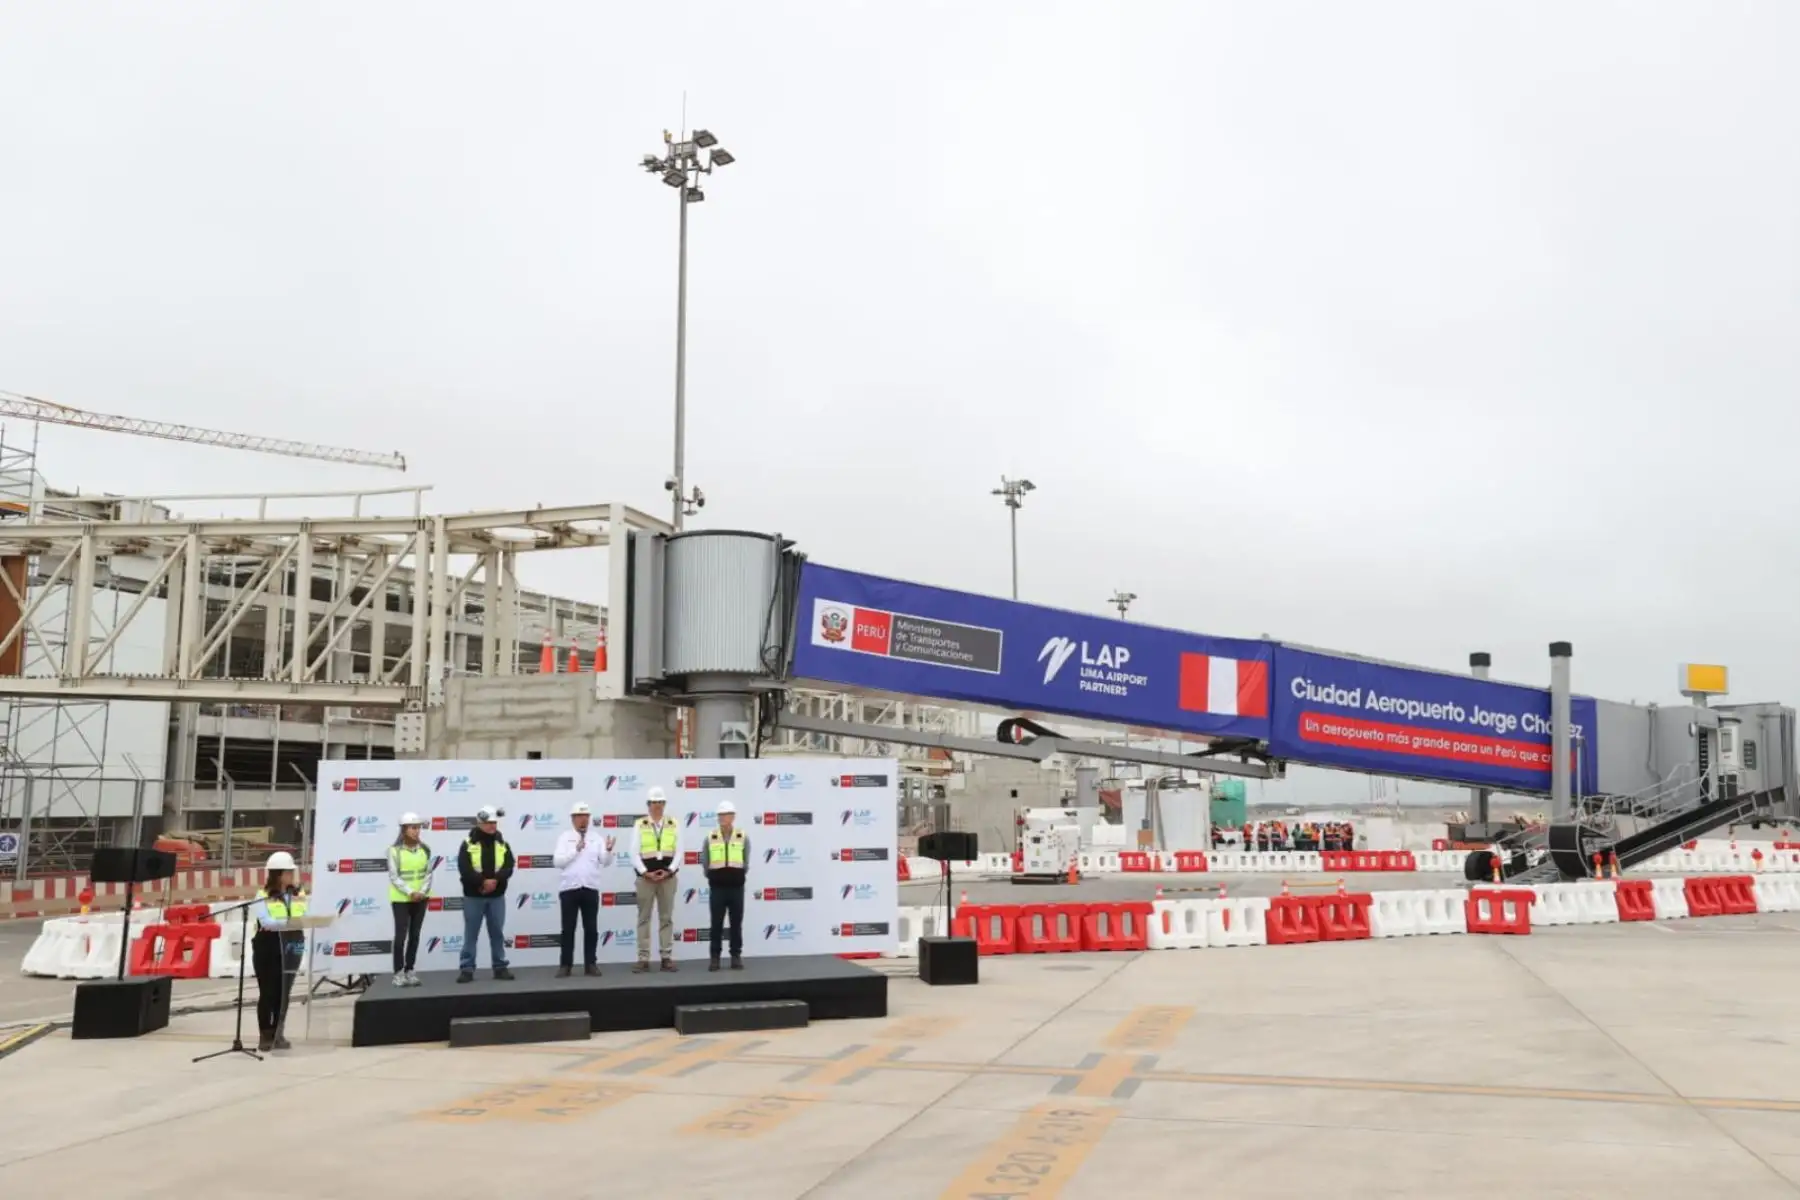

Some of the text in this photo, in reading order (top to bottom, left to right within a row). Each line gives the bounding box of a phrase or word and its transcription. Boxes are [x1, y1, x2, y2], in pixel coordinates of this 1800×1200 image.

[856, 623, 887, 640] PERÚ
[896, 620, 942, 637] Ministerio
[895, 631, 961, 650] de Transportes
[902, 643, 974, 662] Comunicaciones
[1081, 640, 1131, 669] LAP
[1080, 667, 1148, 687] LIMA AIRPORT
[1080, 680, 1128, 697] PARTNERS
[1290, 676, 1584, 740] Ciudad Aeropuerto Jorge Chez
[1305, 719, 1320, 733] Un
[1322, 722, 1384, 742] aeropuerto
[1387, 730, 1409, 745] más
[1412, 735, 1450, 749] grande
[1453, 740, 1478, 754] para
[1480, 745, 1493, 755] un
[1495, 744, 1517, 759] Perú
[1520, 751, 1539, 763] que
